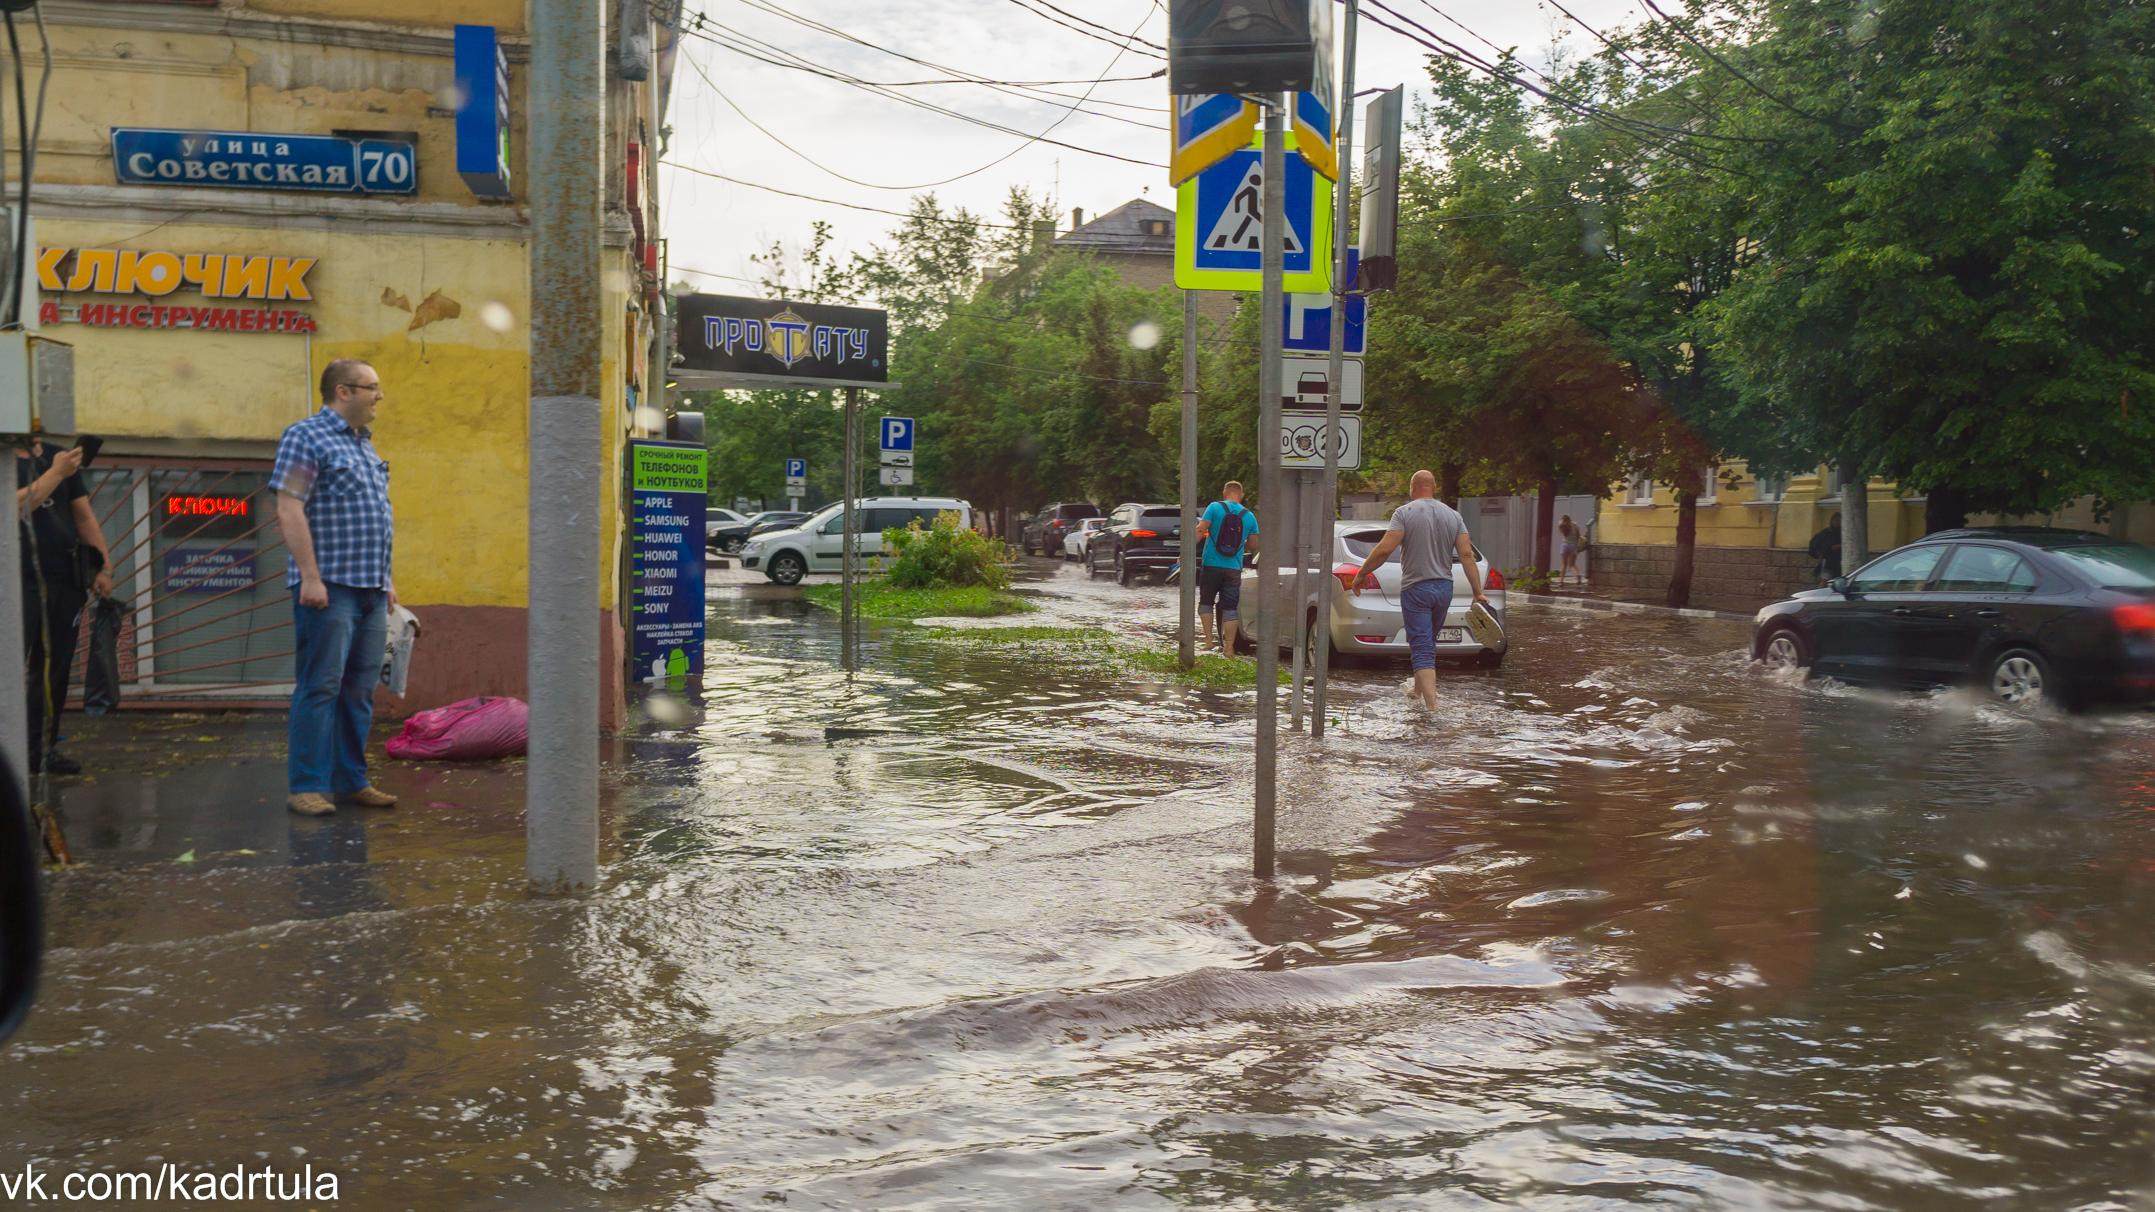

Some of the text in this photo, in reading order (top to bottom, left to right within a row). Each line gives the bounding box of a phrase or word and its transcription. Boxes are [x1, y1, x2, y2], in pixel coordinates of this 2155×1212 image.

[183, 137, 289, 157] улица
[128, 152, 349, 185] Советская
[362, 151, 409, 183] 70
[37, 248, 319, 300] КЛЮЧИК
[888, 421, 906, 448] P
[640, 450, 702, 461] СРОЧНЫЙ РЕМОНТ
[640, 462, 699, 475] ТЕЛЕФОНОВ
[790, 461, 802, 476] P
[646, 476, 704, 489] НОУТБУКОВ
[169, 497, 247, 516] КЛЮЧИ
[644, 497, 673, 508] APPLE
[644, 515, 690, 527] SAMSUNG
[644, 533, 682, 544] HUAWEI
[644, 550, 678, 561] HONOR
[169, 566, 252, 576] МНИКЮНЫХ
[644, 568, 677, 579] XIAOMI
[168, 578, 253, 588] ИНСУМЕНТОВ
[644, 585, 673, 596] MEIZU
[644, 603, 670, 614] SONY
